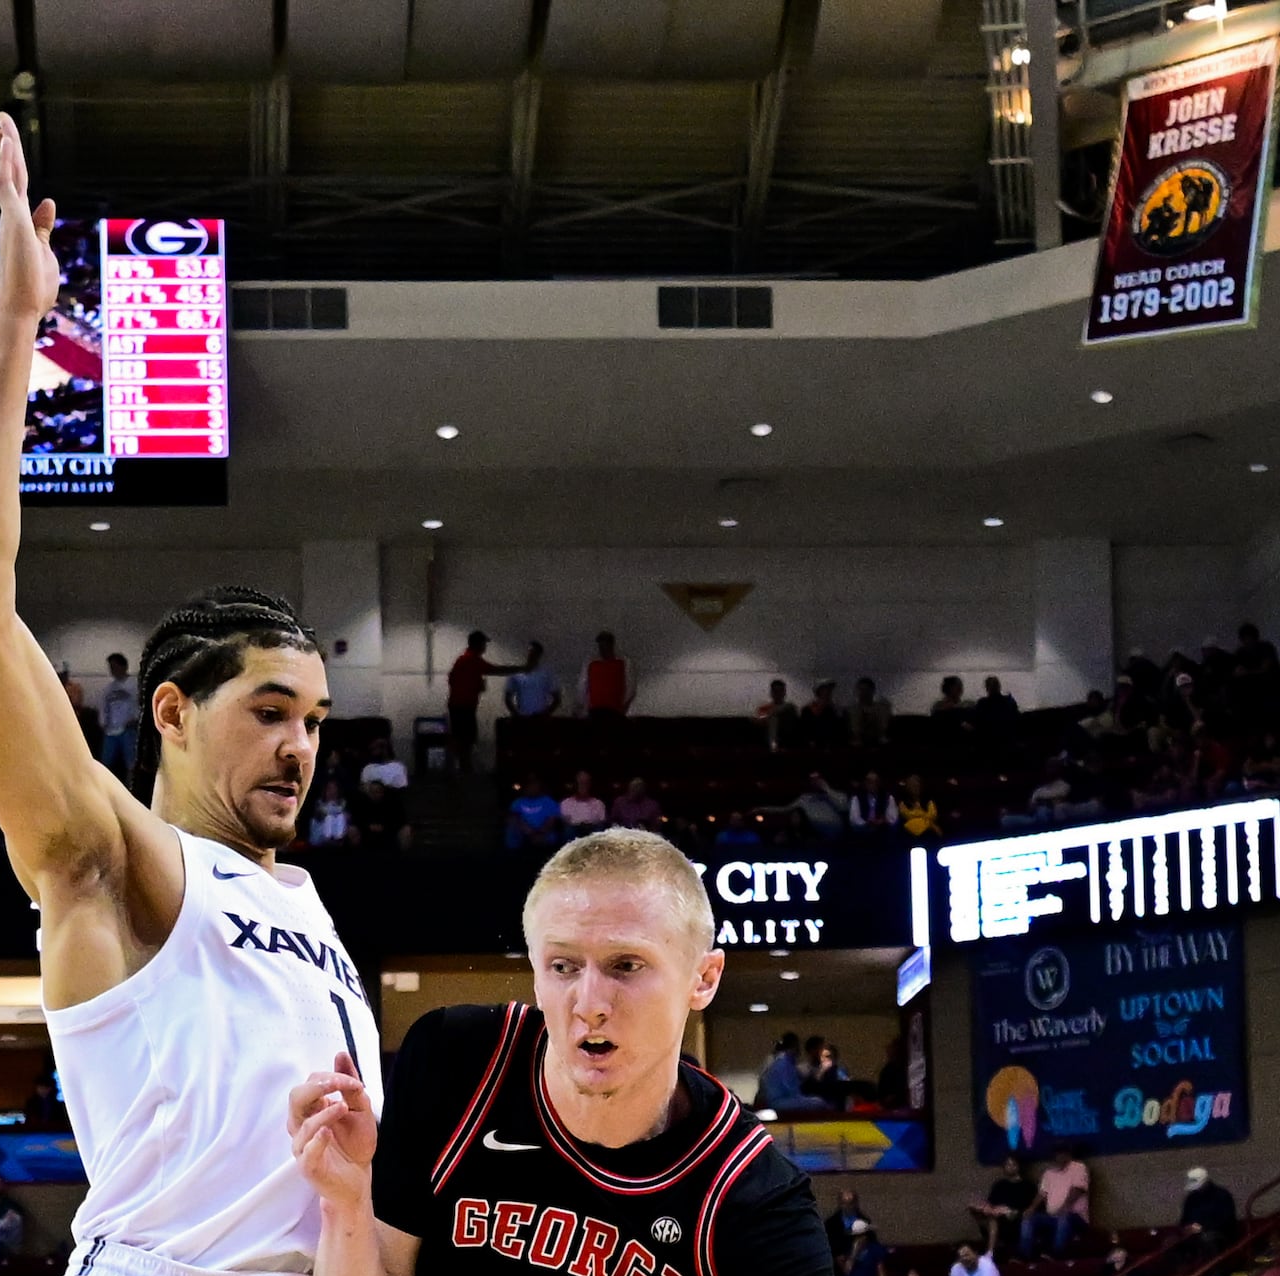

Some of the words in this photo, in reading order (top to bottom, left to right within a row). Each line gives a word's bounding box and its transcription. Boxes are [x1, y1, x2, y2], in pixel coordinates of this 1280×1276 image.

[1165, 87, 1227, 126] JOHN
[1146, 114, 1238, 160] KRESSE
[1114, 265, 1161, 289] HEAD
[1165, 259, 1225, 283] COACH
[1097, 277, 1236, 325] 1979-2002
[109, 335, 147, 354] AST
[206, 335, 221, 354] 6
[196, 361, 222, 379] 15
[207, 386, 222, 405] 3
[207, 411, 223, 430] 3
[208, 436, 223, 456] 3
[70, 457, 116, 475] CITY
[717, 861, 829, 904] CITY
[222, 911, 368, 1006] XAVIE
[1177, 929, 1234, 966] WAY
[1120, 985, 1224, 1021] UPTOWN
[330, 989, 365, 1089] 1
[993, 1018, 1027, 1044] The
[1030, 1006, 1107, 1038] Waverly
[1130, 1036, 1216, 1069] SOCIAL
